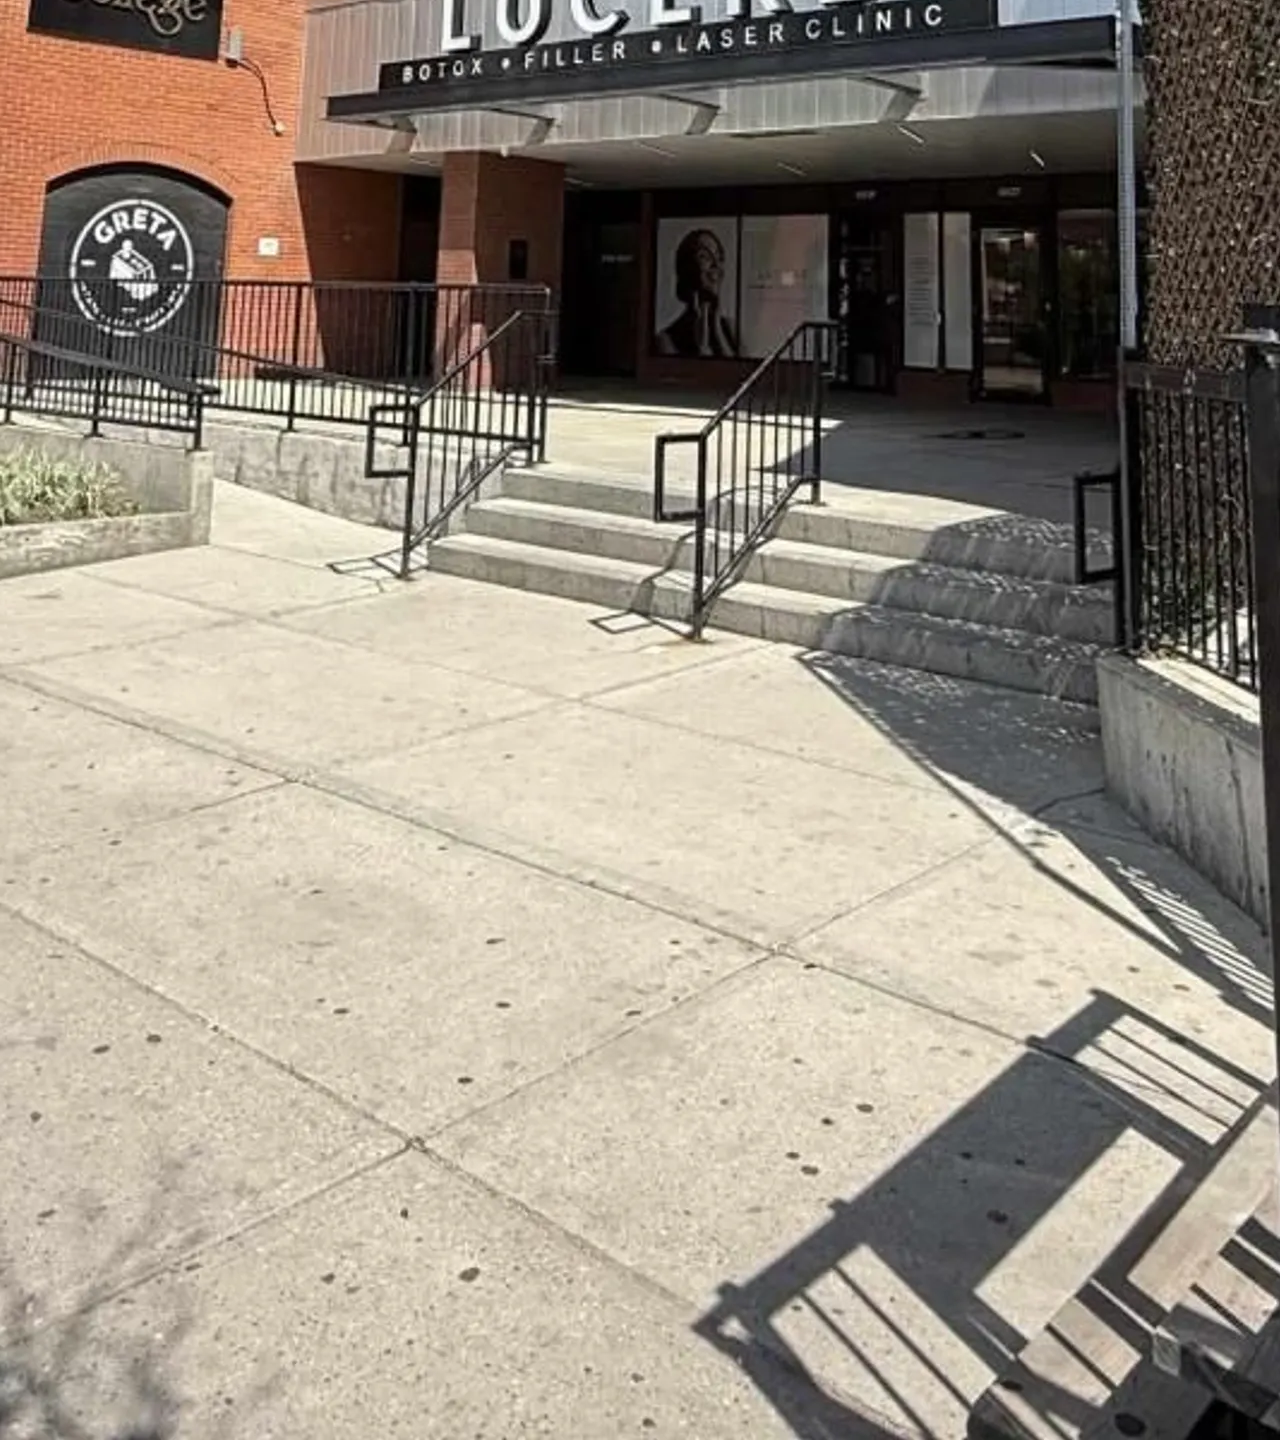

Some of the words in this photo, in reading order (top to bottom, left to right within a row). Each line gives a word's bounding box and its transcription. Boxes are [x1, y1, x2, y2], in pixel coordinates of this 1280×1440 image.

[402, 57, 484, 84] BOTOX
[524, 41, 625, 71] FILLER
[676, 21, 785, 54] LASER
[805, 4, 943, 39] CLINIC
[94, 207, 177, 251] GRETA
